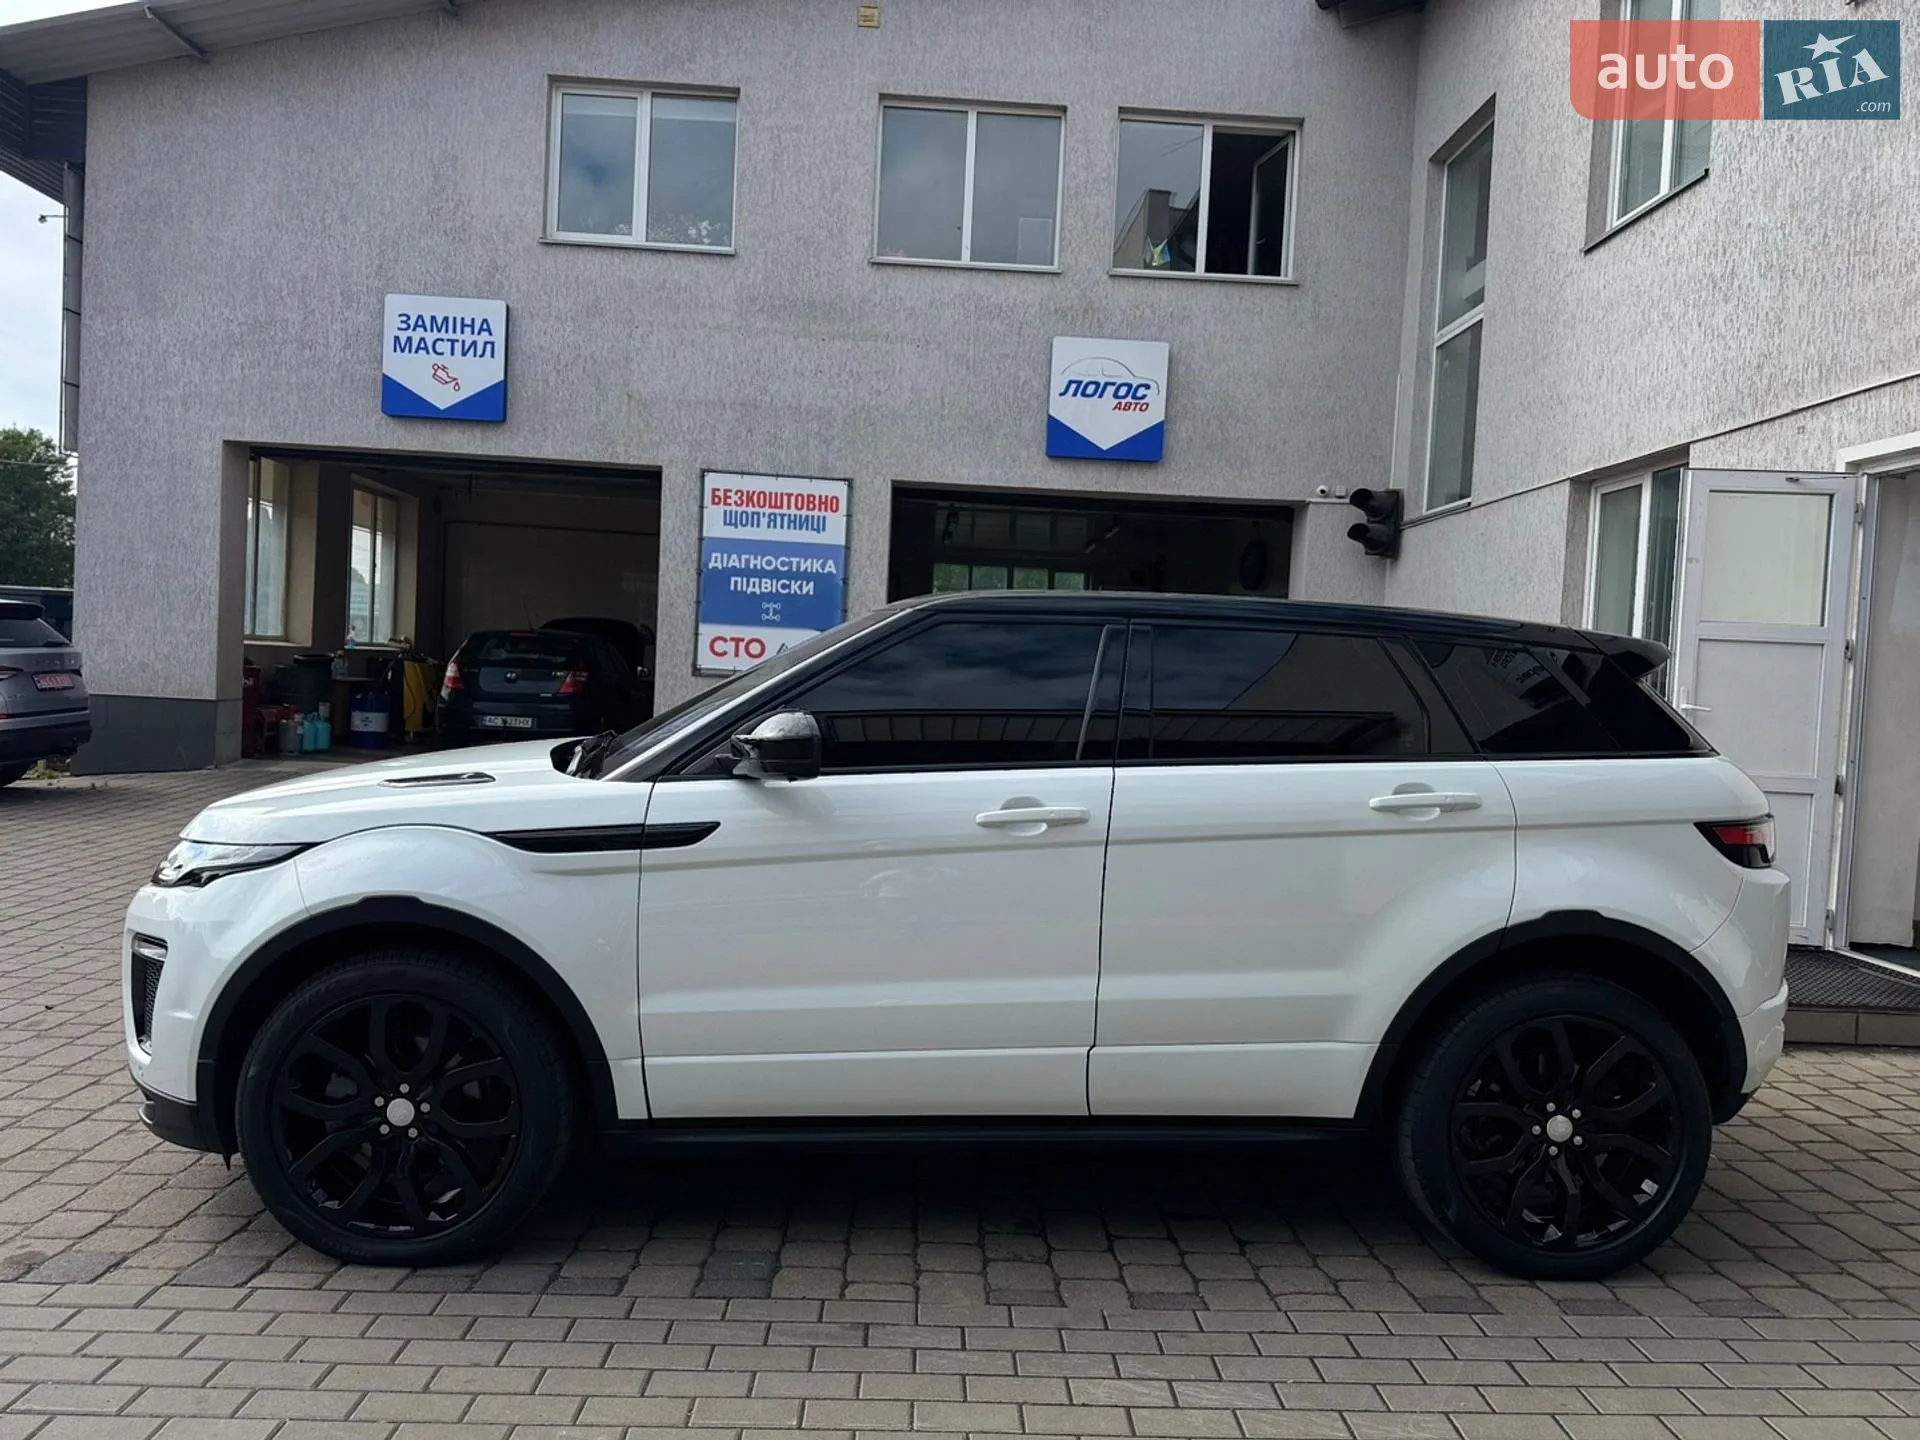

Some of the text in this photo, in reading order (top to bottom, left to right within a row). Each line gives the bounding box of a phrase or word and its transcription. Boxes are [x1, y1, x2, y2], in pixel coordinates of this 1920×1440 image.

[397, 313, 493, 336] ЗАМІНА
[393, 335, 496, 359] МАСТИЛ
[1058, 379, 1151, 401] ЛОГОС
[1112, 401, 1150, 412] АВТО
[711, 487, 840, 513] БЕЗКОШТОВНО
[723, 509, 827, 534] ЩОП'ЯТНИЦІ
[708, 552, 837, 574] ДІАГНОСТИКА
[730, 576, 814, 596] ПІДВІСКИ
[709, 635, 767, 660] СТО
